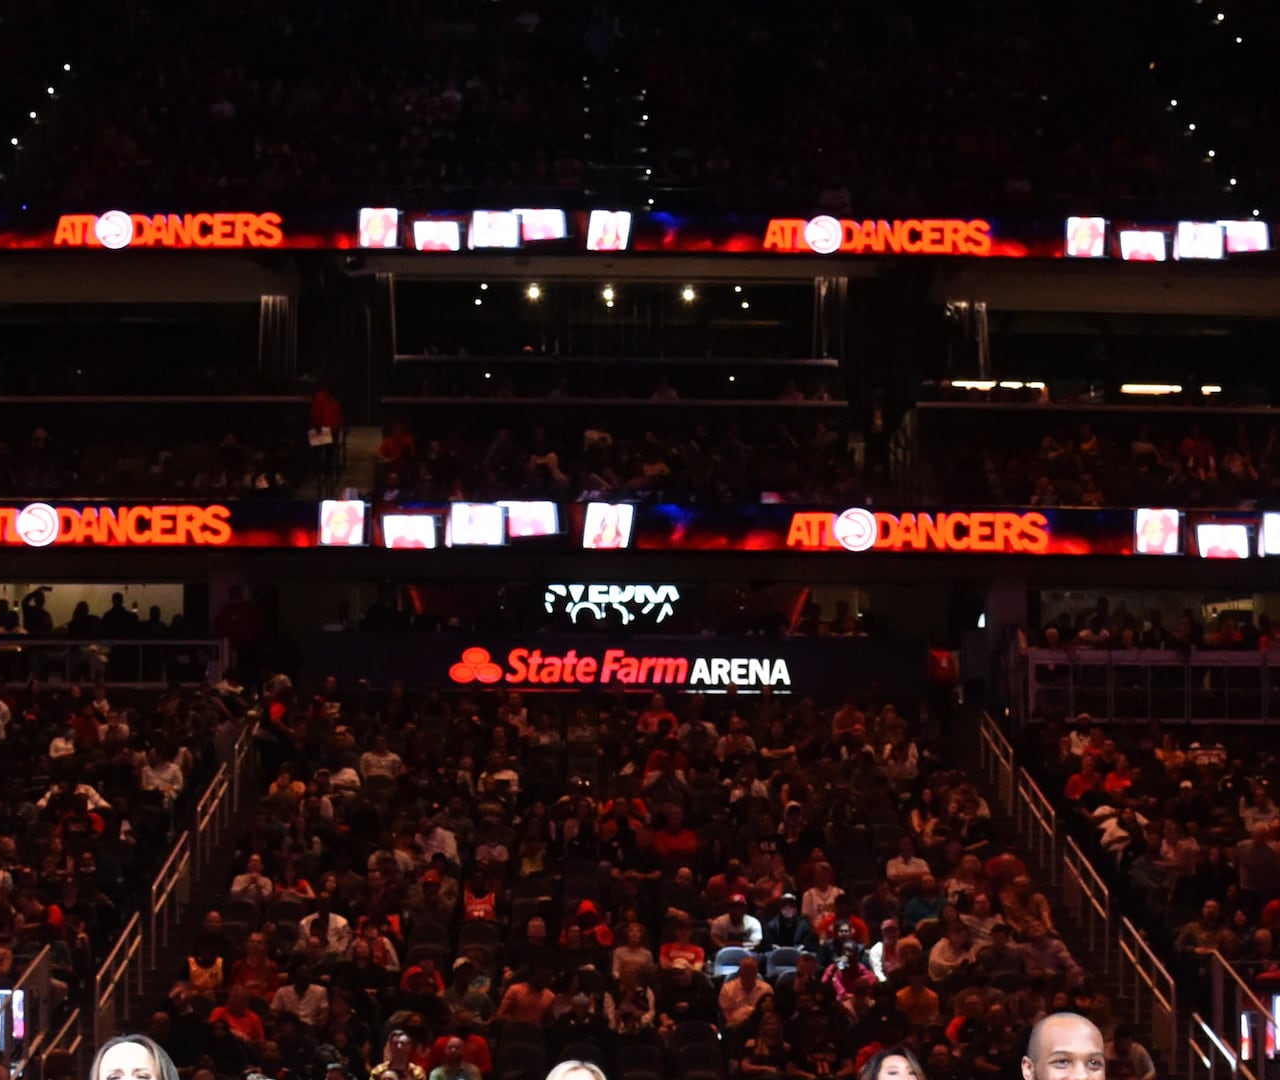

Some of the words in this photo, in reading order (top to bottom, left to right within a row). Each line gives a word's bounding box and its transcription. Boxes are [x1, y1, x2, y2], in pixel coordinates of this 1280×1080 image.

[132, 212, 283, 248] DANCERS
[842, 218, 991, 254] DANCERS
[58, 505, 232, 545] DANCERS
[875, 512, 1049, 551] DANCERS
[506, 649, 596, 683] State
[600, 649, 689, 684] Farm
[690, 658, 791, 685] ARENA
